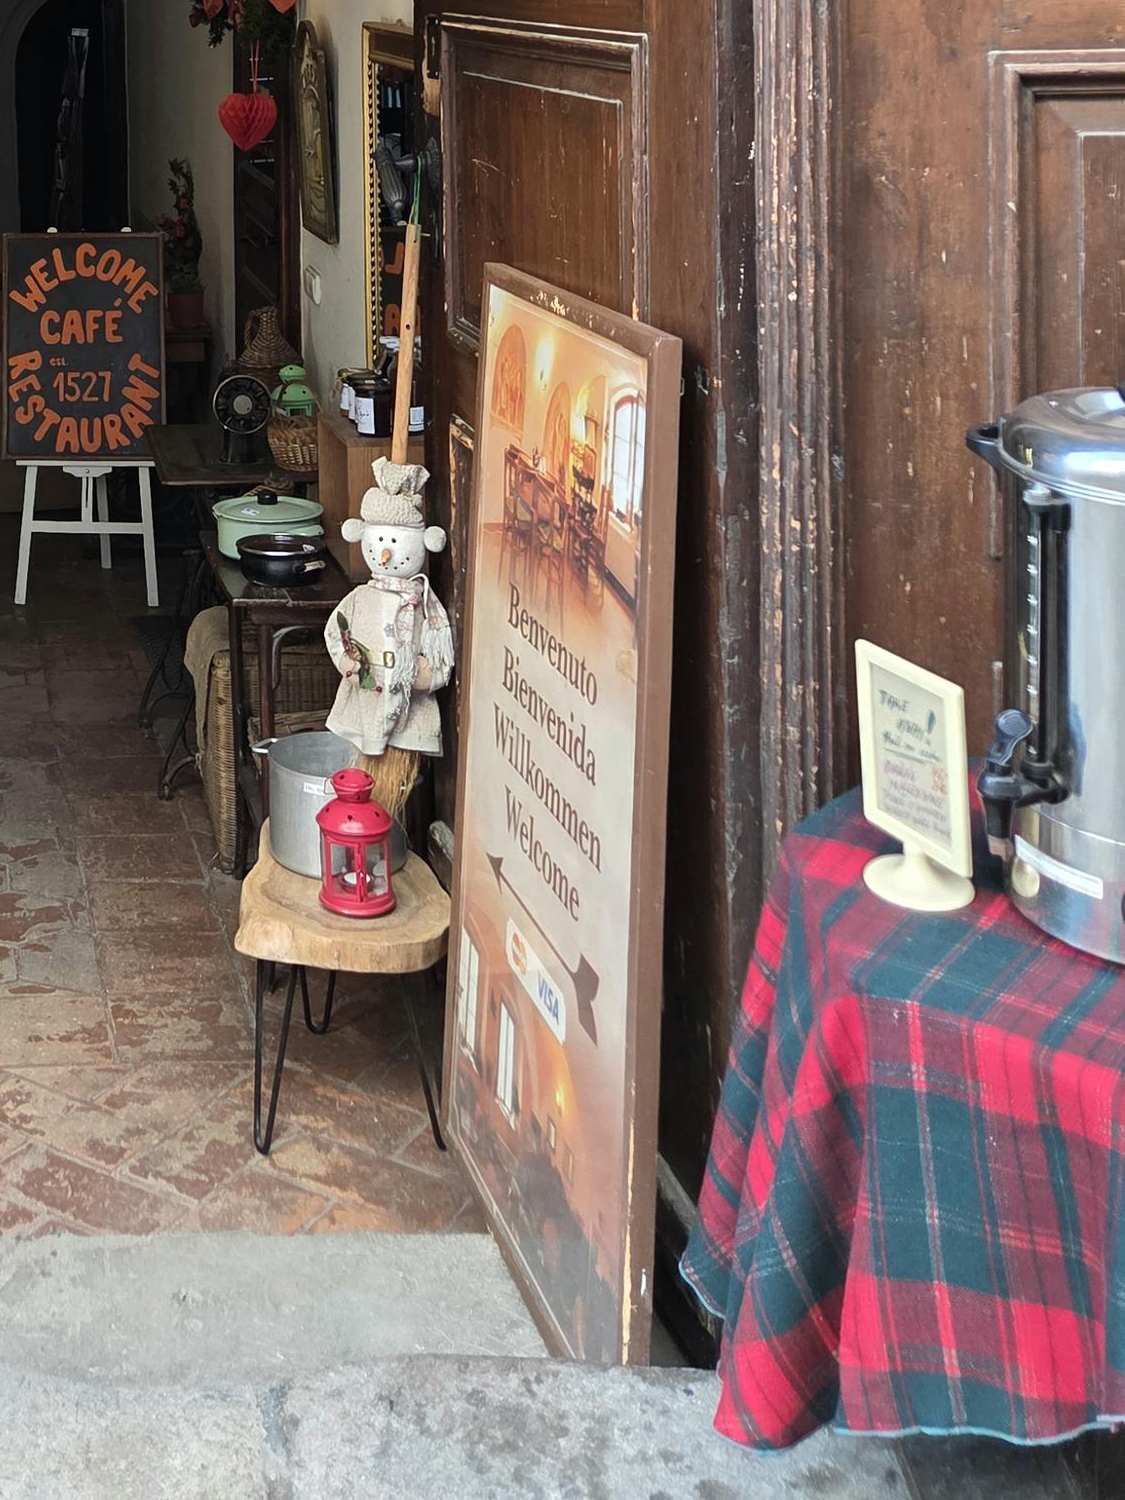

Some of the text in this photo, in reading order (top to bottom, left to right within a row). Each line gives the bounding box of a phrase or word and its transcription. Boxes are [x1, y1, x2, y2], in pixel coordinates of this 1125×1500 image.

[9, 242, 159, 314] WELCOME
[39, 297, 123, 345] CAFÉ
[8, 350, 160, 453] RESTAURANT
[507, 583, 598, 706] Benvenuto
[502, 645, 597, 787] Bienvenida
[492, 701, 602, 874] Willkommen
[504, 784, 580, 922] Welcome
[538, 970, 559, 1026] VISA
